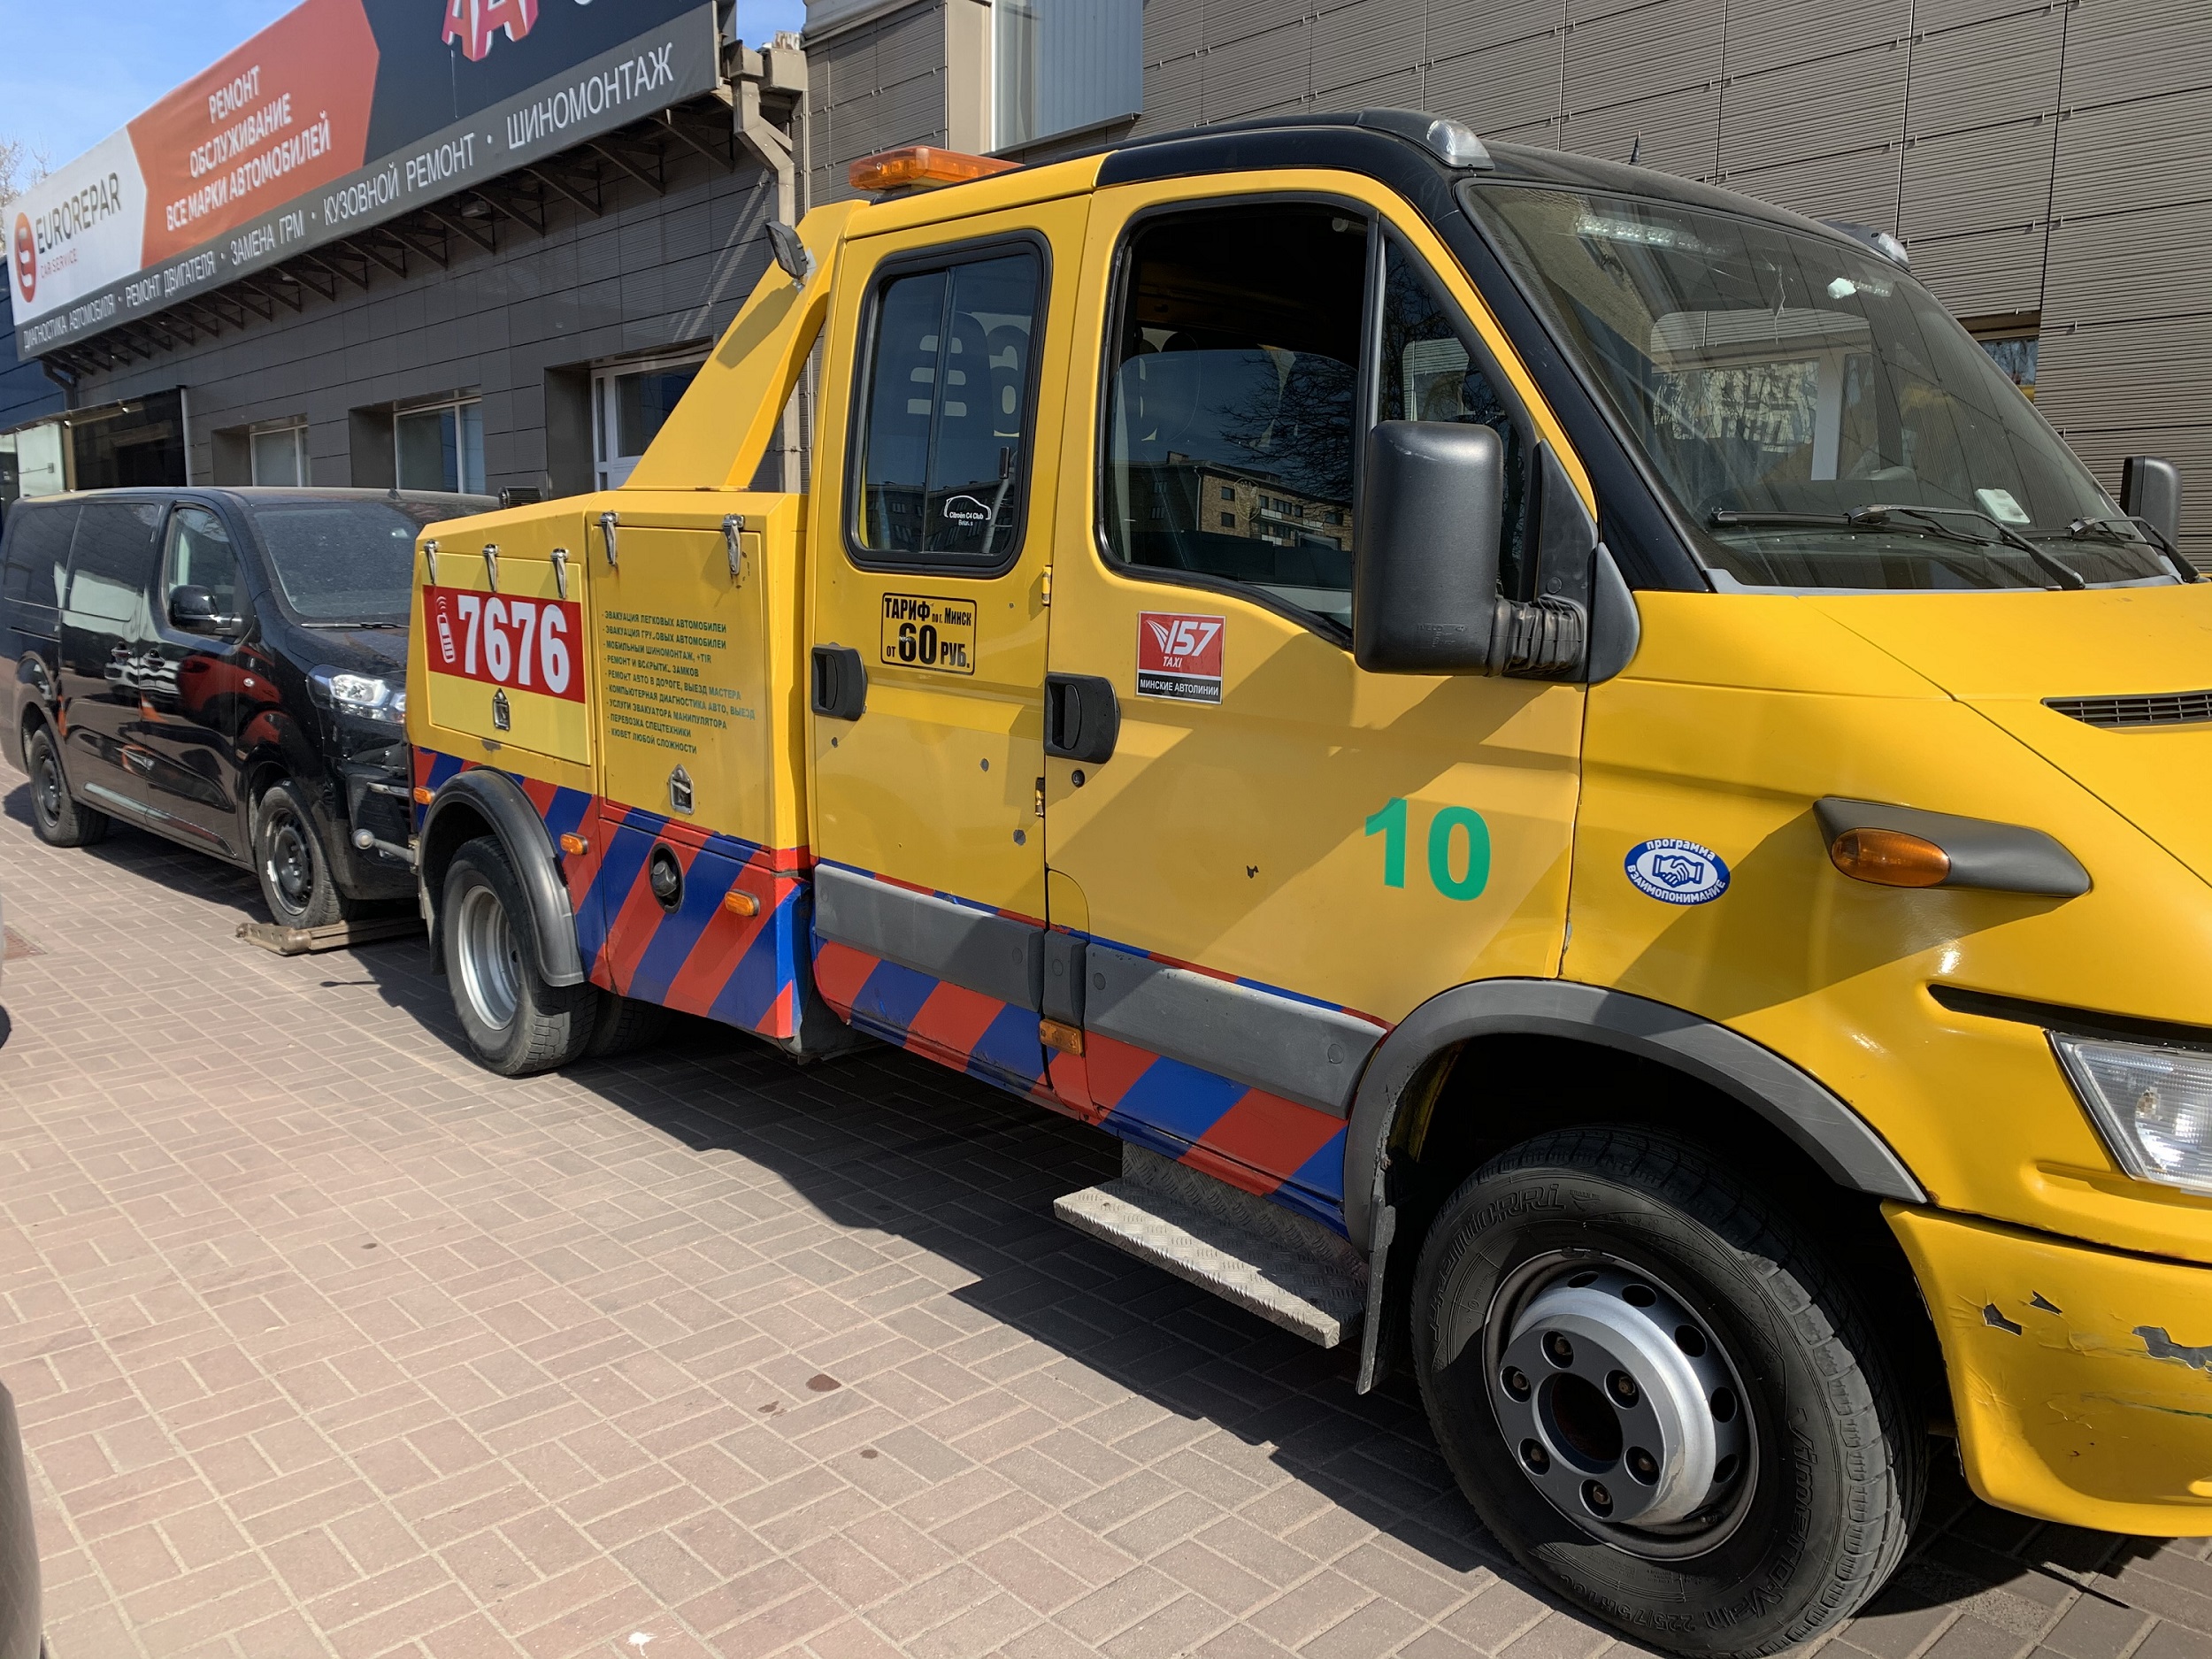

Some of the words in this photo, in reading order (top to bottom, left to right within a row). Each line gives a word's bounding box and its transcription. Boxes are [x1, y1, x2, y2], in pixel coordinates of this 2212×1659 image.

[208, 65, 260, 123] РЕМОНТ
[189, 93, 292, 179] ОБСЛУЖИВАНИЕ
[165, 199, 188, 231] ВСЕ
[188, 181, 227, 224] МАРКИ
[229, 110, 332, 200] АВТОМОБИЛЕЙ
[23, 317, 68, 352] ДИАГНОСТИКА
[69, 294, 116, 332] АВТОМОБИЛЯ
[126, 273, 161, 308] РЕМОНТ
[164, 250, 217, 297] ДВИГАТЕЛЯ
[230, 224, 274, 265] ЗАМЕНА
[279, 210, 304, 244] ГРМ
[323, 163, 400, 227] КУЗОВНОЙ
[405, 133, 477, 192] РЕМОНТ
[506, 42, 675, 150] ШИНОМОНТАЖ
[35, 173, 121, 254] EUROREPAR
[40, 260, 52, 279] CAR
[52, 248, 78, 273] SERVICE
[604, 611, 639, 623] ЭВАКУАЦИЯ
[641, 615, 674, 626] ЛЕГКОВЫХ
[885, 597, 929, 622] ТАРИФ
[457, 594, 570, 694] 7676
[605, 626, 640, 638] ЭВАКУАЦИЯ
[641, 630, 674, 642] ГРУОВЫХ
[899, 622, 937, 664] 60
[941, 641, 971, 668] РУБ.
[607, 655, 631, 665] РЕМОНТ
[632, 658, 636, 667] И
[672, 664, 699, 677] ЗАМКОВ
[646, 645, 695, 663] ШИНОМОНТАЖ,
[1163, 656, 1182, 668] TAXI
[608, 670, 631, 681] РЕМОНТ
[633, 674, 649, 685] АВТО
[684, 682, 708, 696] ВЫЕЗД
[709, 687, 741, 701] МАСТЕРА
[1140, 679, 1173, 691] МИНСКИЕ
[1174, 682, 1218, 696] АВТОЛИНИИ
[609, 684, 658, 700] КОМПЬЮТЕРНАЯ
[659, 694, 706, 710] ДИАГНОСТИКА
[730, 706, 756, 720] ВЫЕЗД
[610, 698, 631, 710] УСЛУГИ
[633, 703, 672, 718] ЭВАКУАТОРА
[673, 711, 727, 729] МАНИПУЛЯТОРА
[611, 713, 644, 727] ПЕРЕВОЗКА
[645, 720, 691, 737] СПЕЦТЕХНИКИ
[611, 728, 631, 739] КЮВЕТ
[633, 733, 655, 745] ЛЮБОЙ
[657, 738, 696, 754] СЛОЖНОСТИ
[1364, 796, 1491, 902] 10
[1647, 839, 1717, 861] программа
[1627, 864, 1725, 902] ВЗАИМОПОНИМАНИЕ
